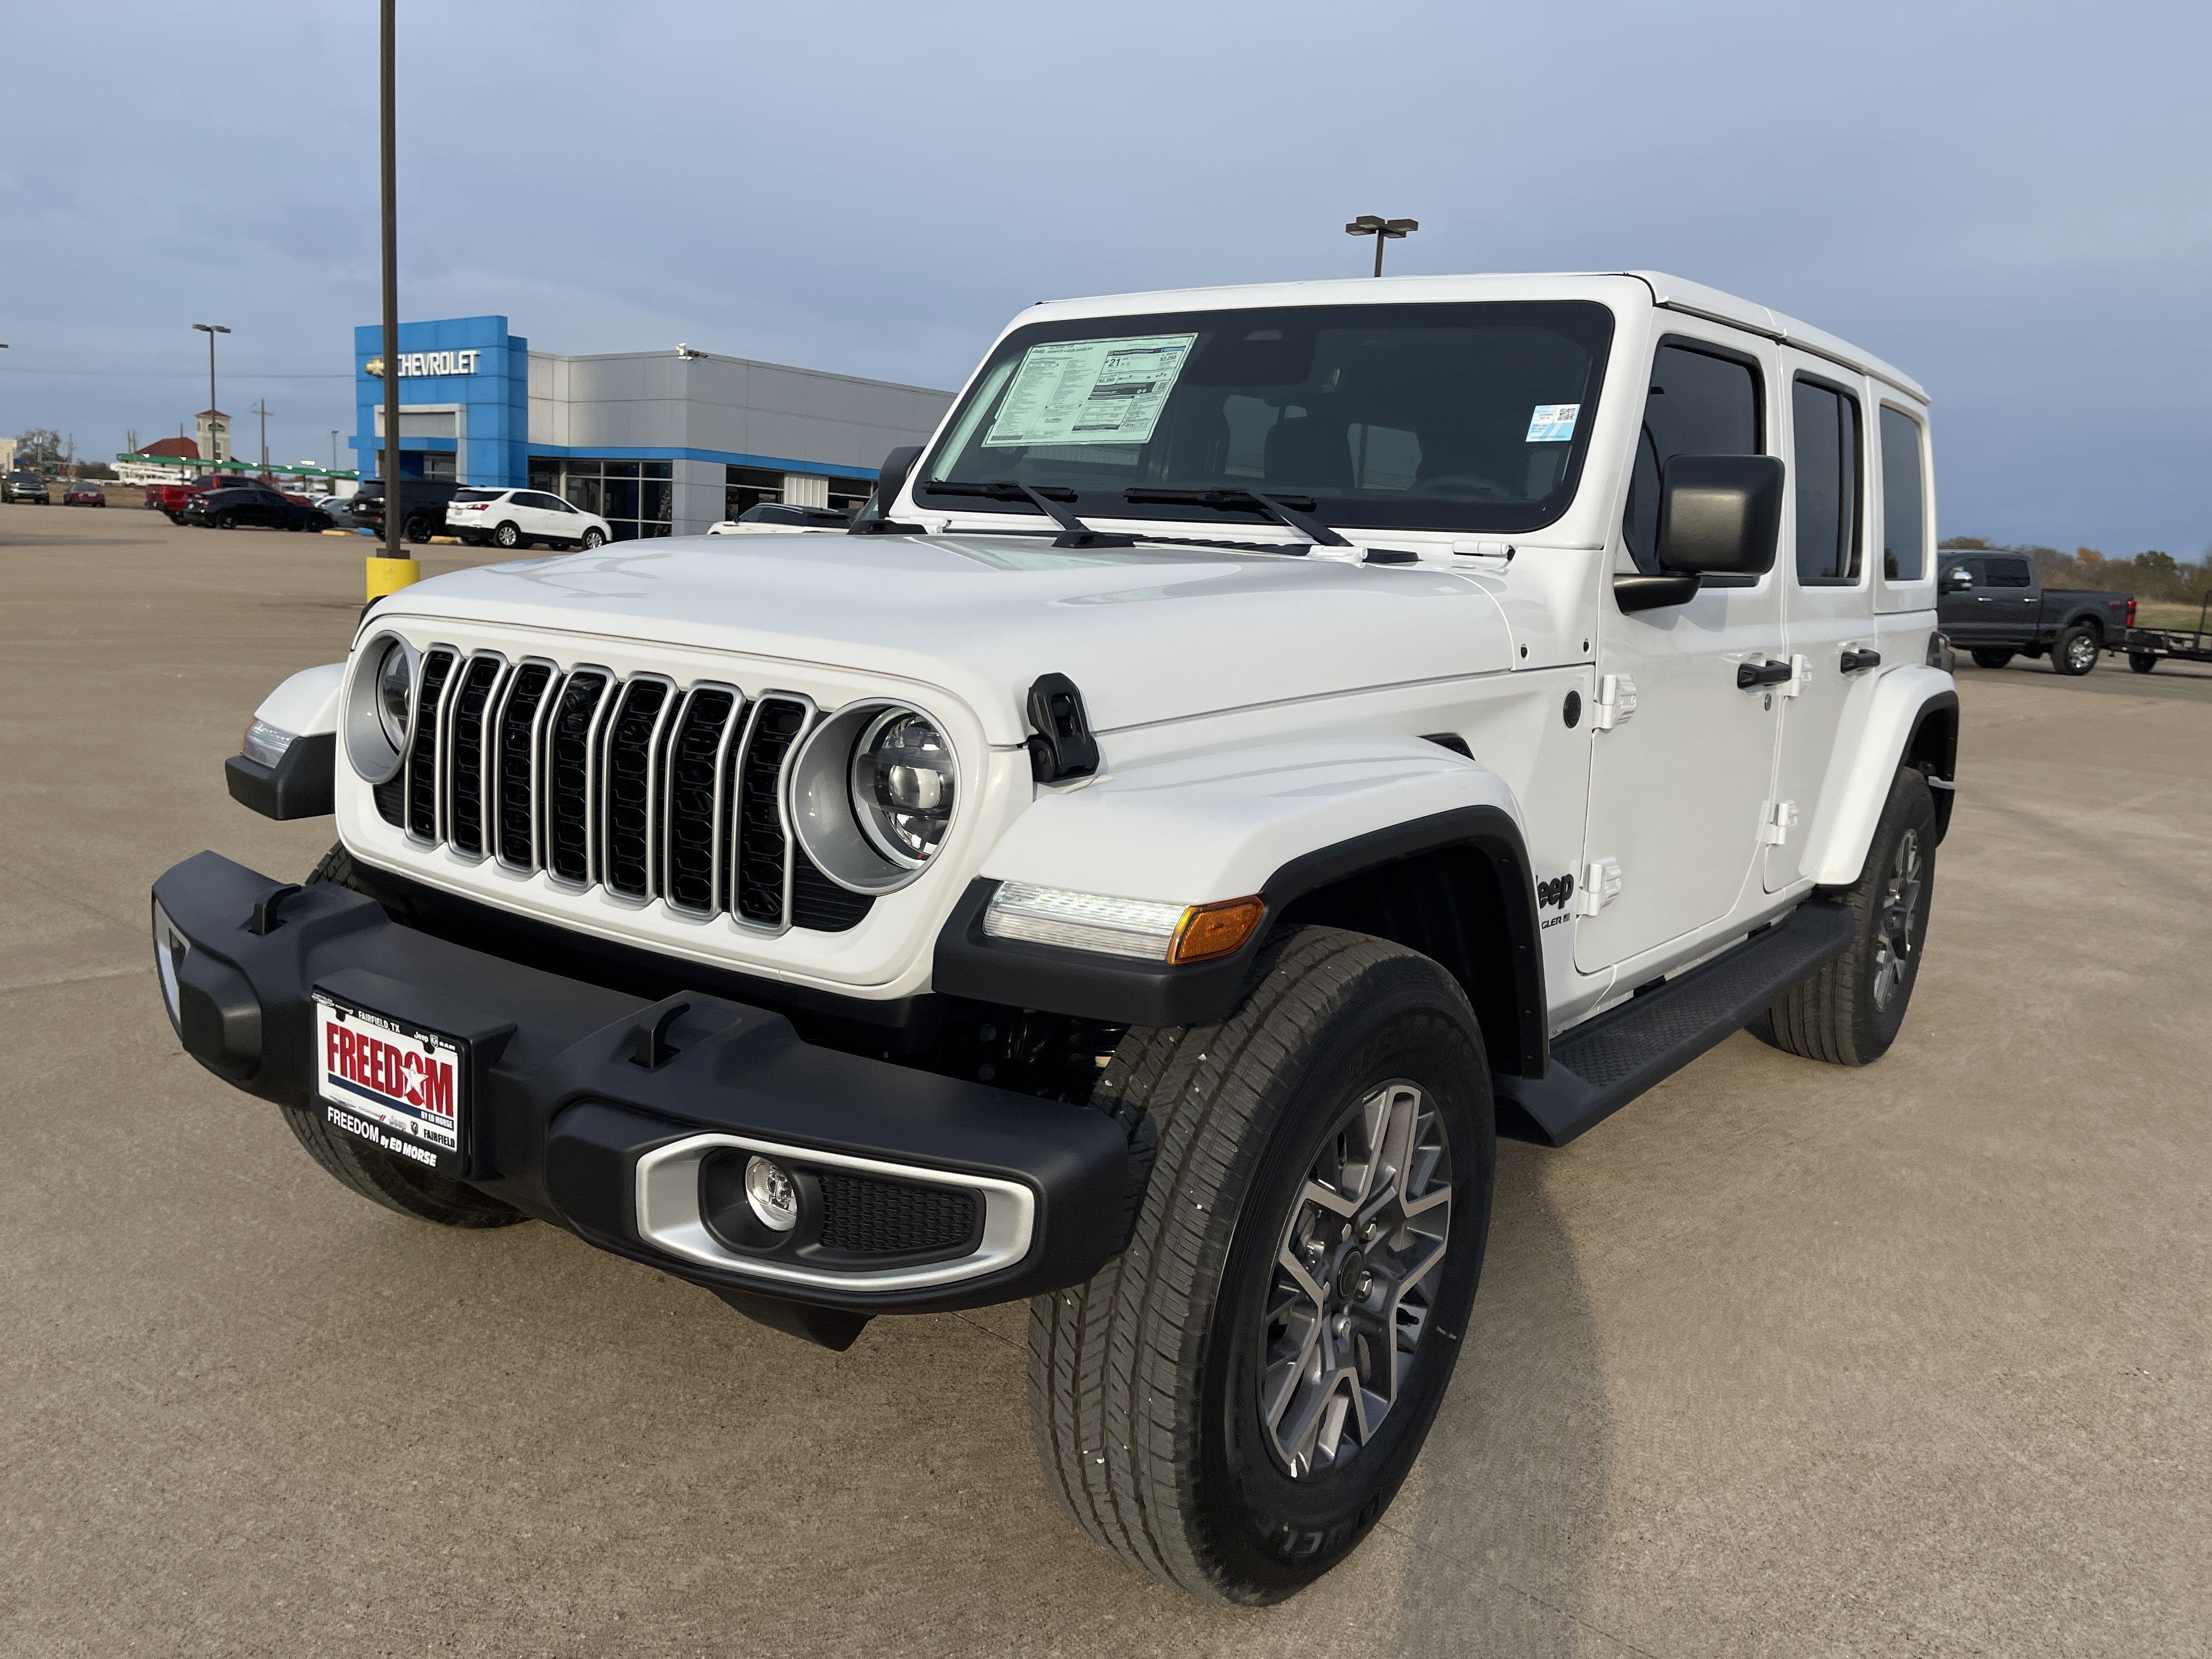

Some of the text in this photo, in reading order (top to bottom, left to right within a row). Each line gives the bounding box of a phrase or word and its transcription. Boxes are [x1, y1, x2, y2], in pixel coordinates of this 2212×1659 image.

[1108, 358, 1121, 367] 21
[1536, 873, 1574, 910] eep
[1542, 916, 1562, 929] GLER
[358, 1010, 400, 1033] FAIRFIELD, TX
[414, 1031, 428, 1043] Jeep
[326, 1021, 454, 1118] FREEDOM
[421, 1110, 453, 1129] BY ED MORSE
[328, 1106, 379, 1143] FREEDOM
[390, 1137, 402, 1153] ED
[402, 1142, 437, 1167] MORSE
[424, 1128, 455, 1148] FAIRFIELD
